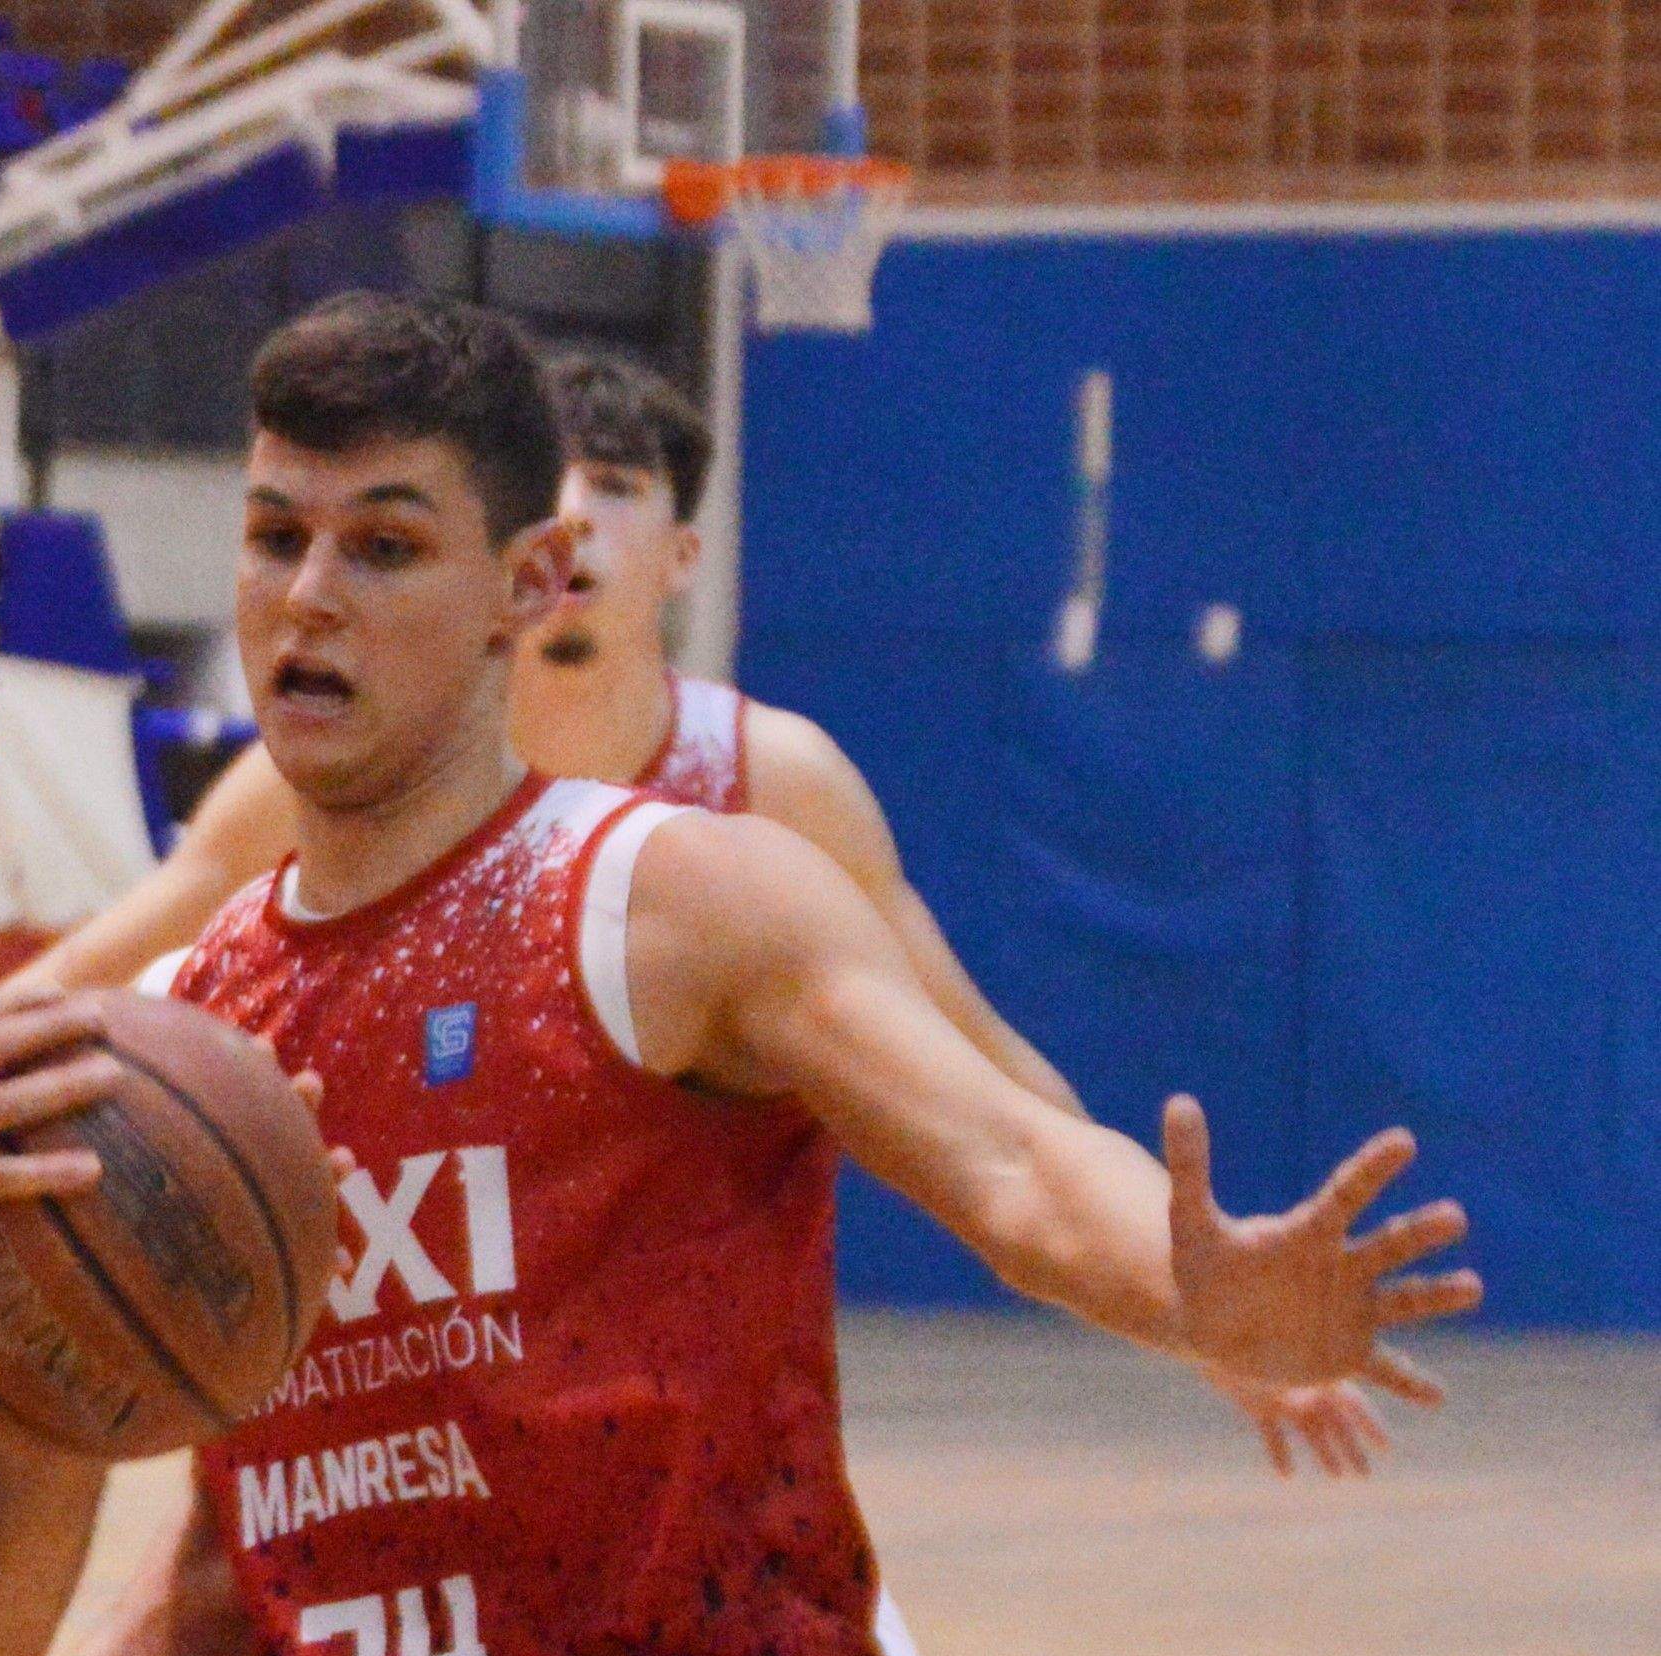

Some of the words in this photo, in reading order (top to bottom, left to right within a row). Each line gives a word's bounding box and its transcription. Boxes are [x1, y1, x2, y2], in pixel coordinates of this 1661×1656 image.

[329, 1144, 518, 1323] XI
[250, 1304, 524, 1420] MATIZACIÓN
[238, 1421, 492, 1549] MANRESA
